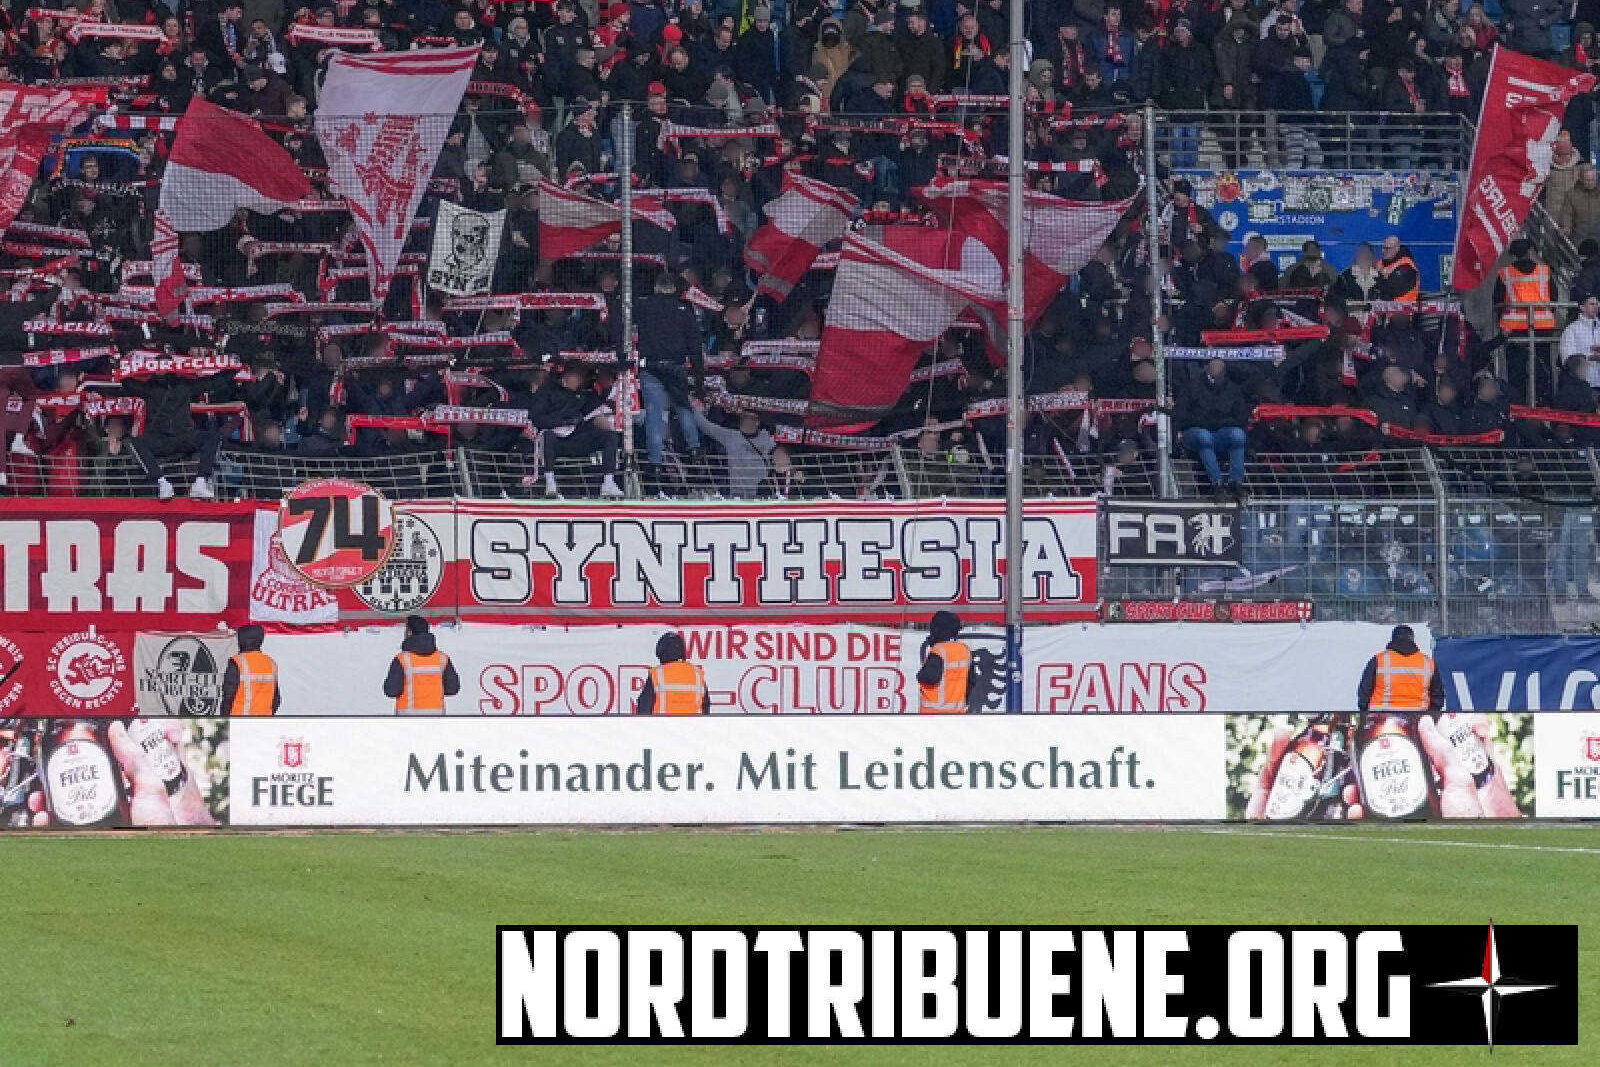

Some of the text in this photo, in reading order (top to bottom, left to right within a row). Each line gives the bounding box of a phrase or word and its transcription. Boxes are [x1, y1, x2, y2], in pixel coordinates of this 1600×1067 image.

[288, 495, 386, 565] 74
[471, 519, 1080, 604] SYNTHESIA
[678, 632, 902, 662] WIR SIND DIE
[1036, 663, 1208, 713] FANS
[269, 772, 316, 784] MORITZ
[402, 745, 1156, 792] Miteinander. Mit Leidenschaft.
[1556, 769, 1600, 800] FIE
[251, 776, 334, 807] FIEGE
